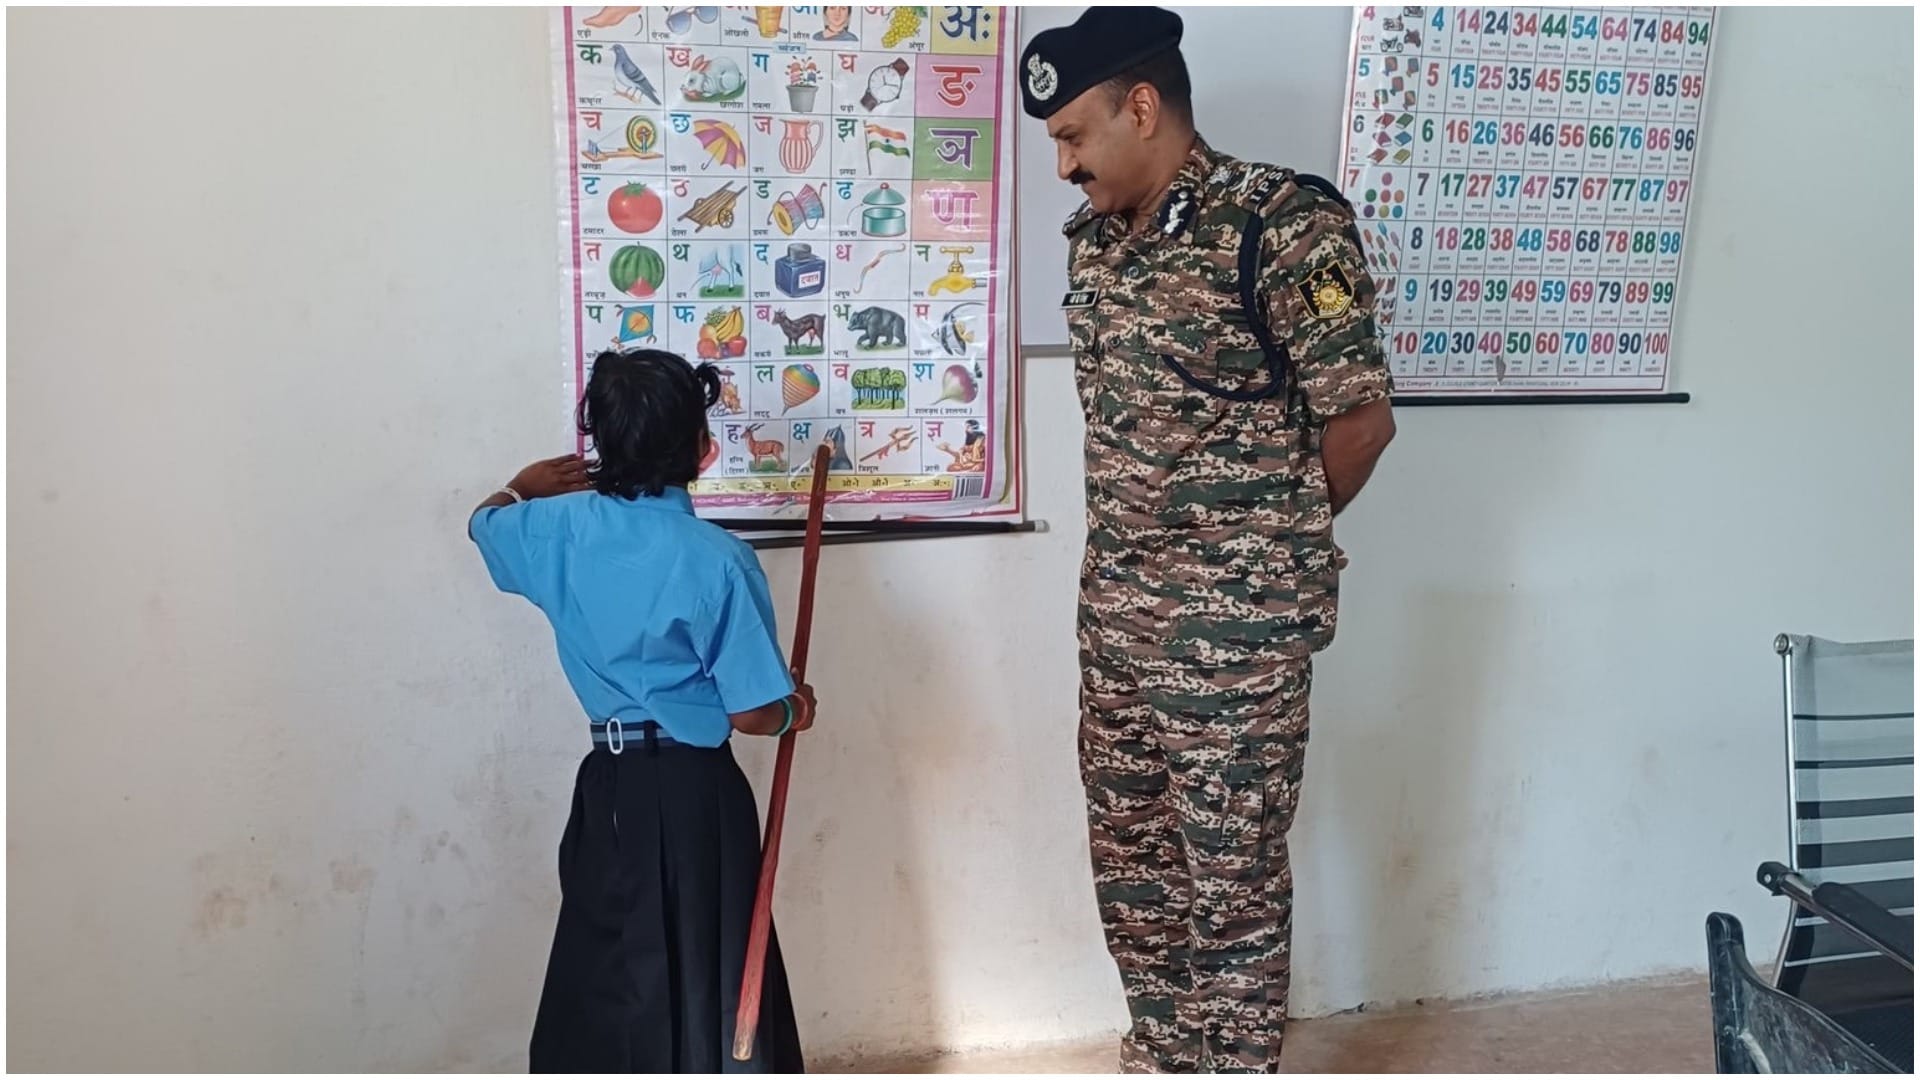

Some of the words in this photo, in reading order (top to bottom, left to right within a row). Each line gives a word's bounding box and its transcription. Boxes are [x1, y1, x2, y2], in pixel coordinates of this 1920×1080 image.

[1364, 6, 1375, 20] 4
[1432, 7, 1444, 31] 4
[1457, 8, 1480, 33] 14
[1484, 11, 1508, 35] 24
[1513, 13, 1537, 36] 34
[1541, 14, 1567, 38] 44
[1572, 16, 1597, 39] 54
[1602, 17, 1627, 41] 64
[1634, 19, 1656, 42] 74
[1661, 21, 1683, 44] 84
[1688, 22, 1709, 45] 94
[577, 44, 603, 65] क
[666, 47, 692, 67] ख
[752, 53, 770, 72] ग
[838, 54, 858, 73] घ
[1359, 58, 1370, 76] 5
[932, 65, 981, 107] ङ
[1427, 63, 1439, 86] 5
[1452, 64, 1475, 88] 15
[1478, 66, 1503, 89] 25
[1507, 67, 1531, 91] 35
[1535, 69, 1561, 92] 45
[1565, 70, 1591, 93] 55
[1596, 71, 1621, 94] 65
[1627, 73, 1650, 95] 75
[1654, 74, 1677, 96] 85
[1681, 75, 1702, 98] 95
[580, 112, 602, 130] च
[670, 113, 690, 133] छ
[752, 116, 773, 135] ज
[835, 118, 858, 141] झ
[1354, 115, 1364, 133] 6
[1422, 119, 1433, 142] 6
[1446, 120, 1469, 143] 16
[1473, 121, 1497, 144] 26
[1501, 122, 1525, 145] 36
[1529, 123, 1554, 146] 46
[1559, 125, 1584, 147] 56
[1589, 126, 1614, 148] 66
[1620, 127, 1642, 149] 76
[1647, 128, 1670, 150] 86
[1674, 129, 1694, 151] 96
[930, 128, 980, 169] ञ
[582, 177, 601, 195] ट
[1250, 171, 1283, 201] IPS
[1349, 169, 1359, 187] 7
[1418, 173, 1429, 196] 7
[1441, 173, 1464, 196] 17
[1467, 174, 1492, 197] 27
[1496, 175, 1520, 198] 37
[1523, 176, 1549, 198] 47
[1553, 177, 1579, 199] 57
[1583, 178, 1608, 200] 67
[1613, 179, 1636, 201] 77
[1640, 179, 1664, 201] 87
[1667, 180, 1688, 202] 97
[671, 179, 690, 197] ठ
[753, 180, 771, 199] ड
[836, 182, 853, 200] ढ
[927, 190, 978, 230] ण
[1411, 227, 1423, 249] 8
[1436, 228, 1458, 250] 18
[1462, 228, 1485, 250] 28
[1490, 228, 1513, 250] 38
[1517, 229, 1542, 251] 48
[1547, 230, 1571, 251] 58
[1576, 230, 1600, 252] 68
[1606, 231, 1628, 252] 78
[1633, 231, 1656, 253] 88
[1660, 232, 1680, 253] 98
[584, 242, 602, 261] त
[673, 244, 690, 262] थ
[754, 244, 769, 264] द
[836, 244, 852, 261] ध
[914, 245, 931, 262] न
[1405, 279, 1417, 301] 9
[1430, 279, 1452, 301] 19
[1456, 280, 1480, 301] 29
[1484, 280, 1507, 301] 39
[1511, 280, 1536, 302] 49
[1541, 281, 1565, 302] 59
[1570, 281, 1593, 302] 69
[1599, 282, 1621, 303] 79
[1626, 282, 1648, 303] 89
[1653, 282, 1673, 303] 99
[585, 305, 603, 323] प
[673, 306, 695, 323] फ
[755, 305, 771, 321] ब
[833, 304, 851, 321] भ
[913, 304, 930, 320] म
[1394, 332, 1417, 353] 10
[1422, 332, 1447, 354] 20
[1451, 332, 1474, 353] 30
[1478, 332, 1502, 354] 40
[1507, 332, 1531, 353] 50
[1536, 333, 1559, 353] 60
[1565, 333, 1587, 354] 70
[1591, 333, 1614, 354] 80
[1619, 333, 1641, 354] 90
[1645, 333, 1667, 354] 100
[755, 365, 774, 383] ल
[833, 364, 850, 380] व
[913, 363, 934, 381] श
[725, 424, 741, 444] ह
[793, 422, 812, 443] क्ष
[858, 422, 875, 438] त्र
[925, 421, 944, 441] ज्ञ
